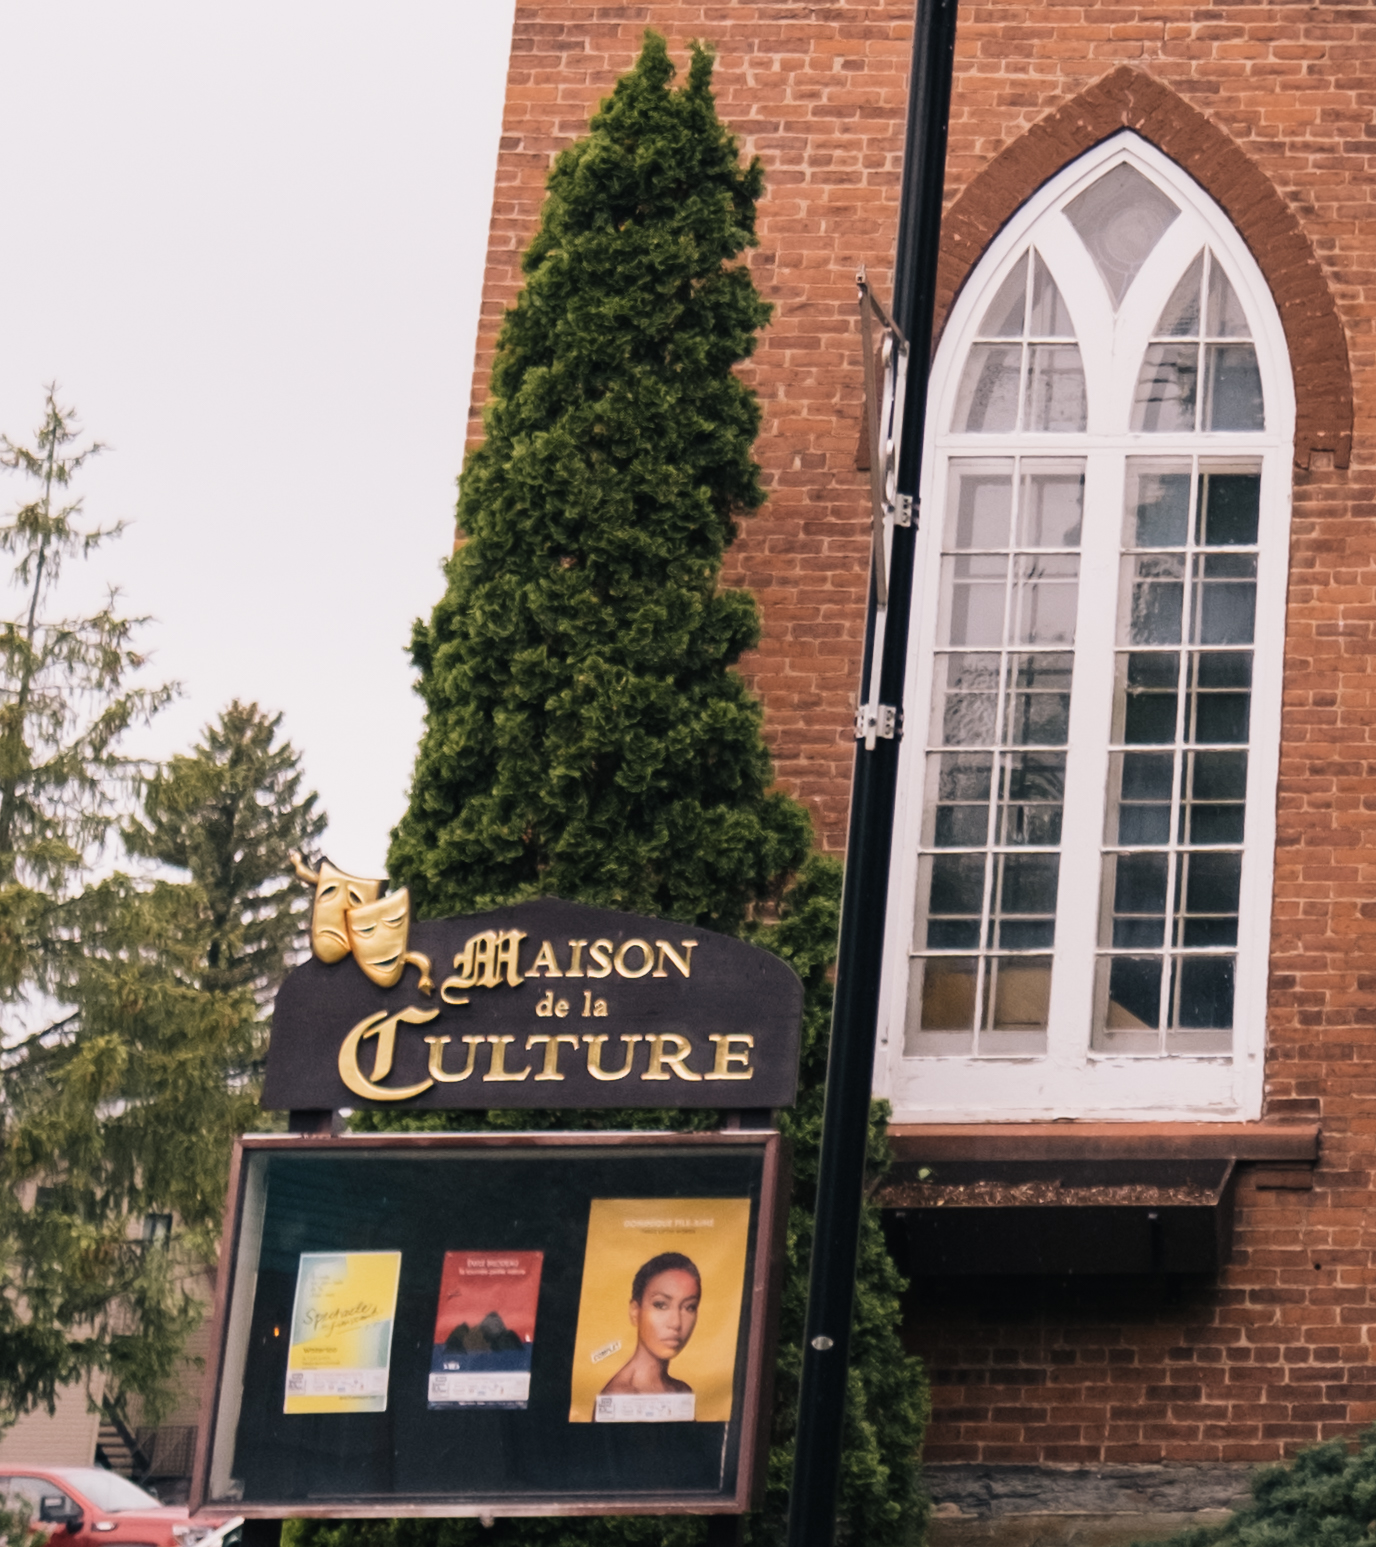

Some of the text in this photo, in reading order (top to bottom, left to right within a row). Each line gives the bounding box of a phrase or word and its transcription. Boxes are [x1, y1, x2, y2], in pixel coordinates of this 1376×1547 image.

[441, 928, 699, 1005] MAISON
[535, 990, 609, 1019] de la
[338, 1006, 755, 1102] CULTURE
